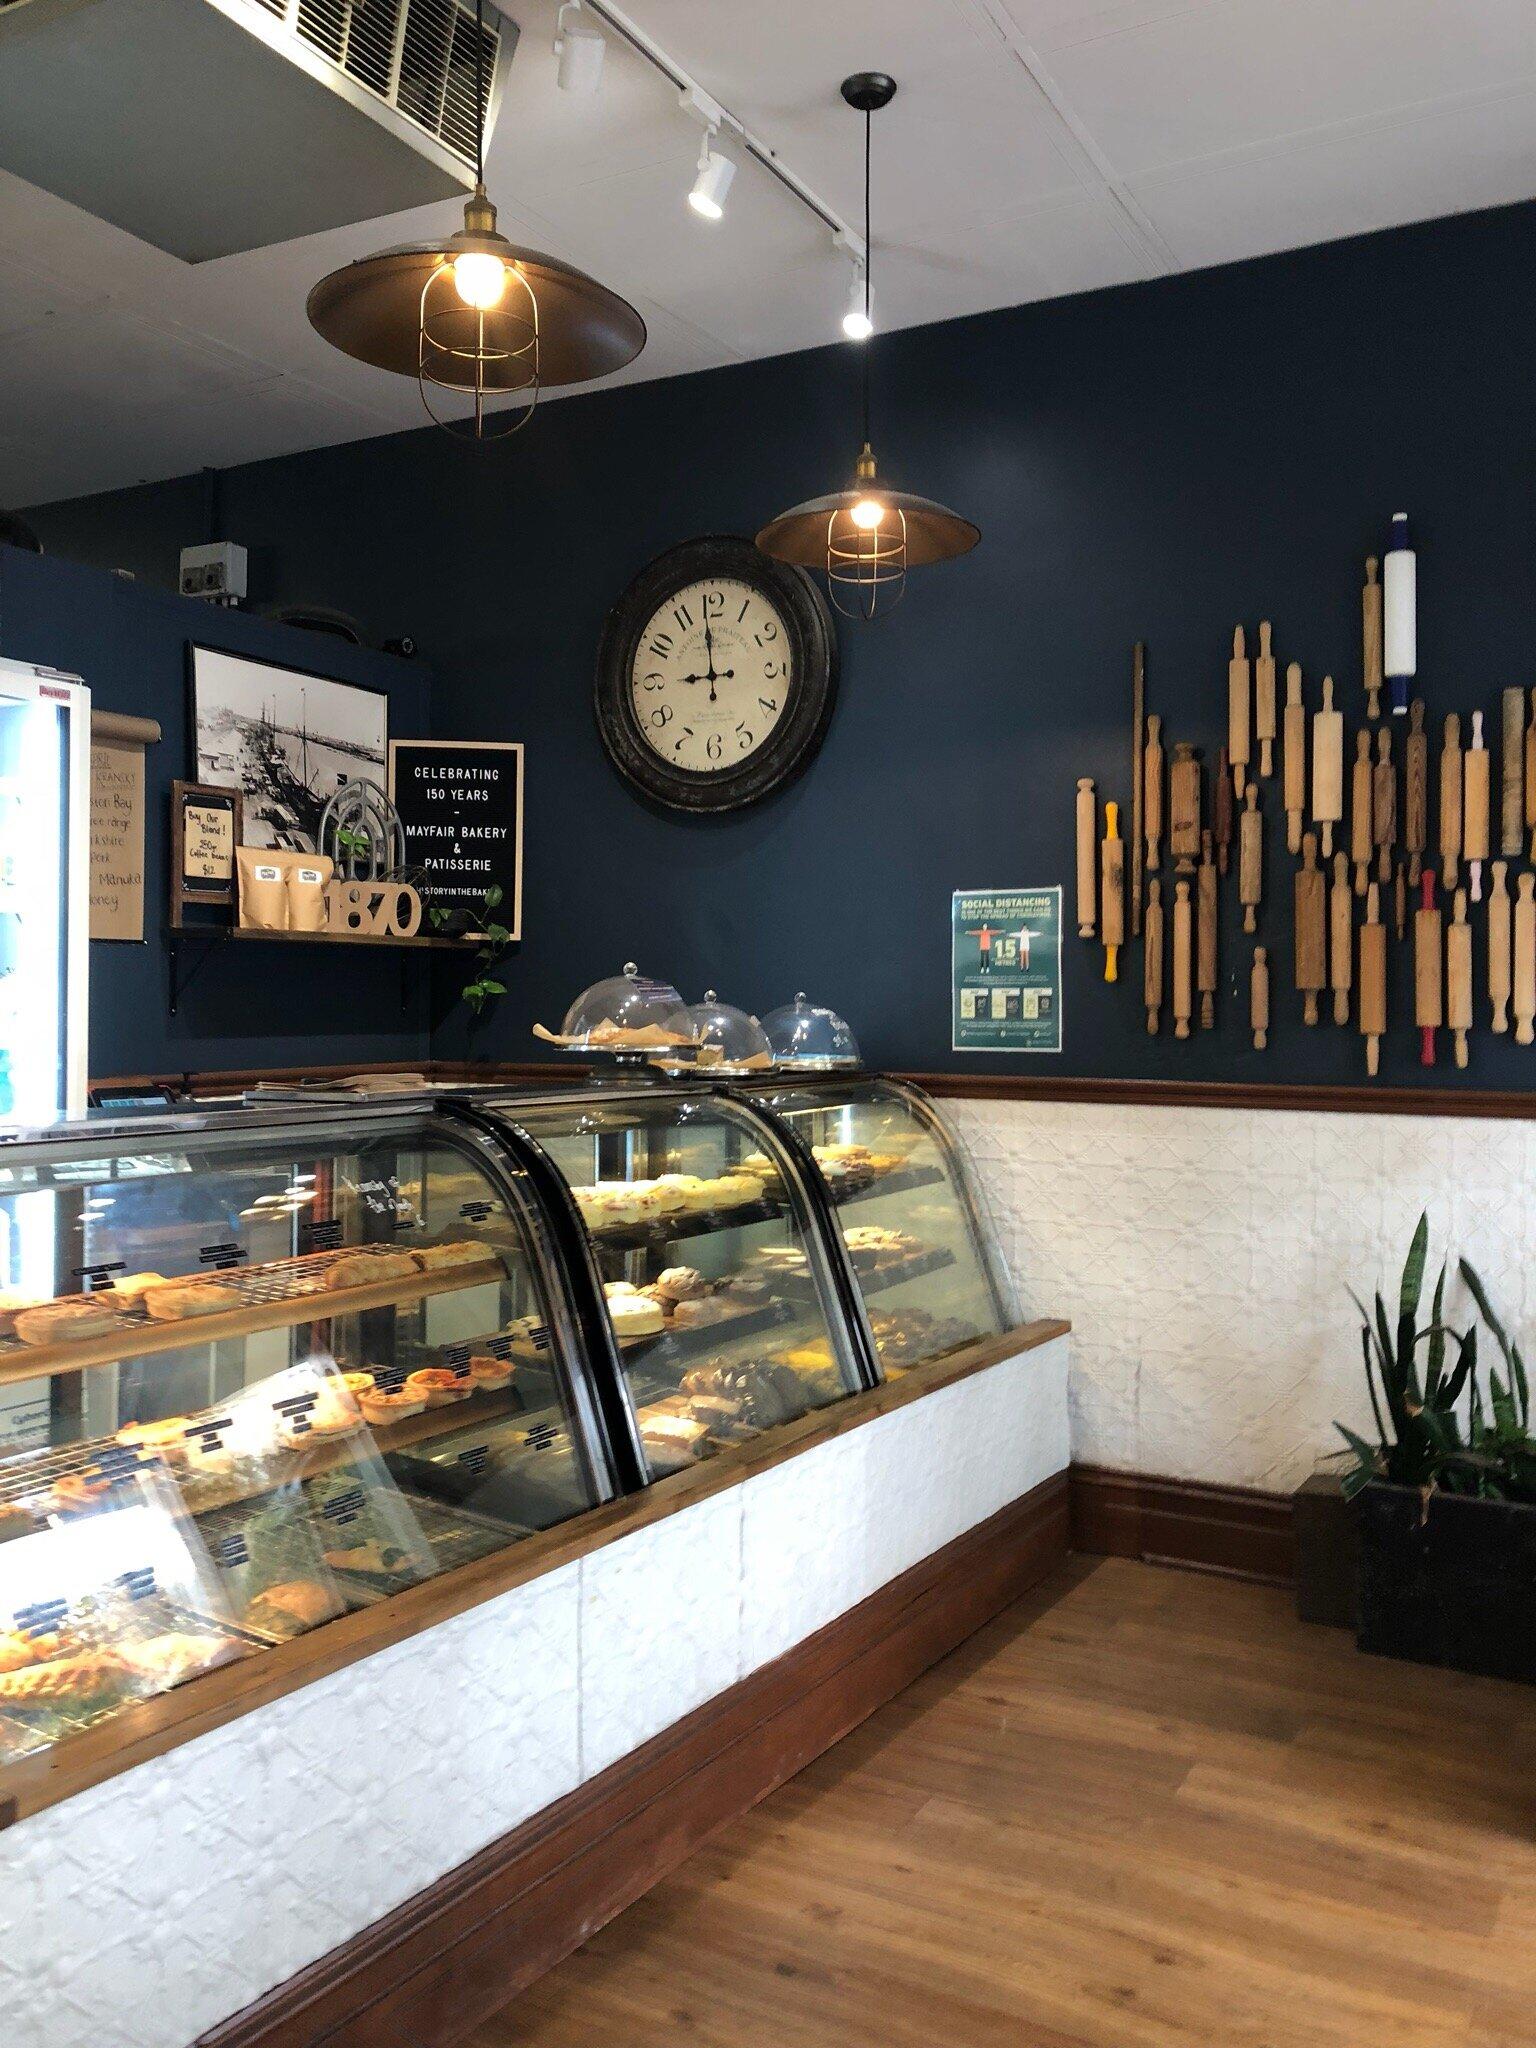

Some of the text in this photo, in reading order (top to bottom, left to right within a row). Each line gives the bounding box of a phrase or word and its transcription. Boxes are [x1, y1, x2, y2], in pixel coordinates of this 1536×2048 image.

[703, 591, 724, 619] 12
[737, 599, 750, 623] 1
[673, 604, 694, 632] 11
[754, 621, 777, 647] 2
[649, 632, 674, 660] 10
[643, 672, 665, 691] 9
[763, 661, 786, 680] 3
[651, 704, 673, 728] 8
[758, 697, 777, 718] 4
[674, 726, 694, 751] 7
[735, 720, 754, 749] 5
[706, 733, 722, 759] 6
[414, 767, 499, 780] CELEBRATING
[426, 788, 489, 801] 150 YEARS
[188, 810, 201, 825] Buy
[406, 825, 508, 838] MAYFAIR BAKERY
[453, 842, 461, 854] &
[424, 858, 492, 871] PATISSERIE
[325, 879, 422, 937] 1870
[962, 899, 994, 909] SOCIAL
[995, 896, 1051, 908] DISTANCING
